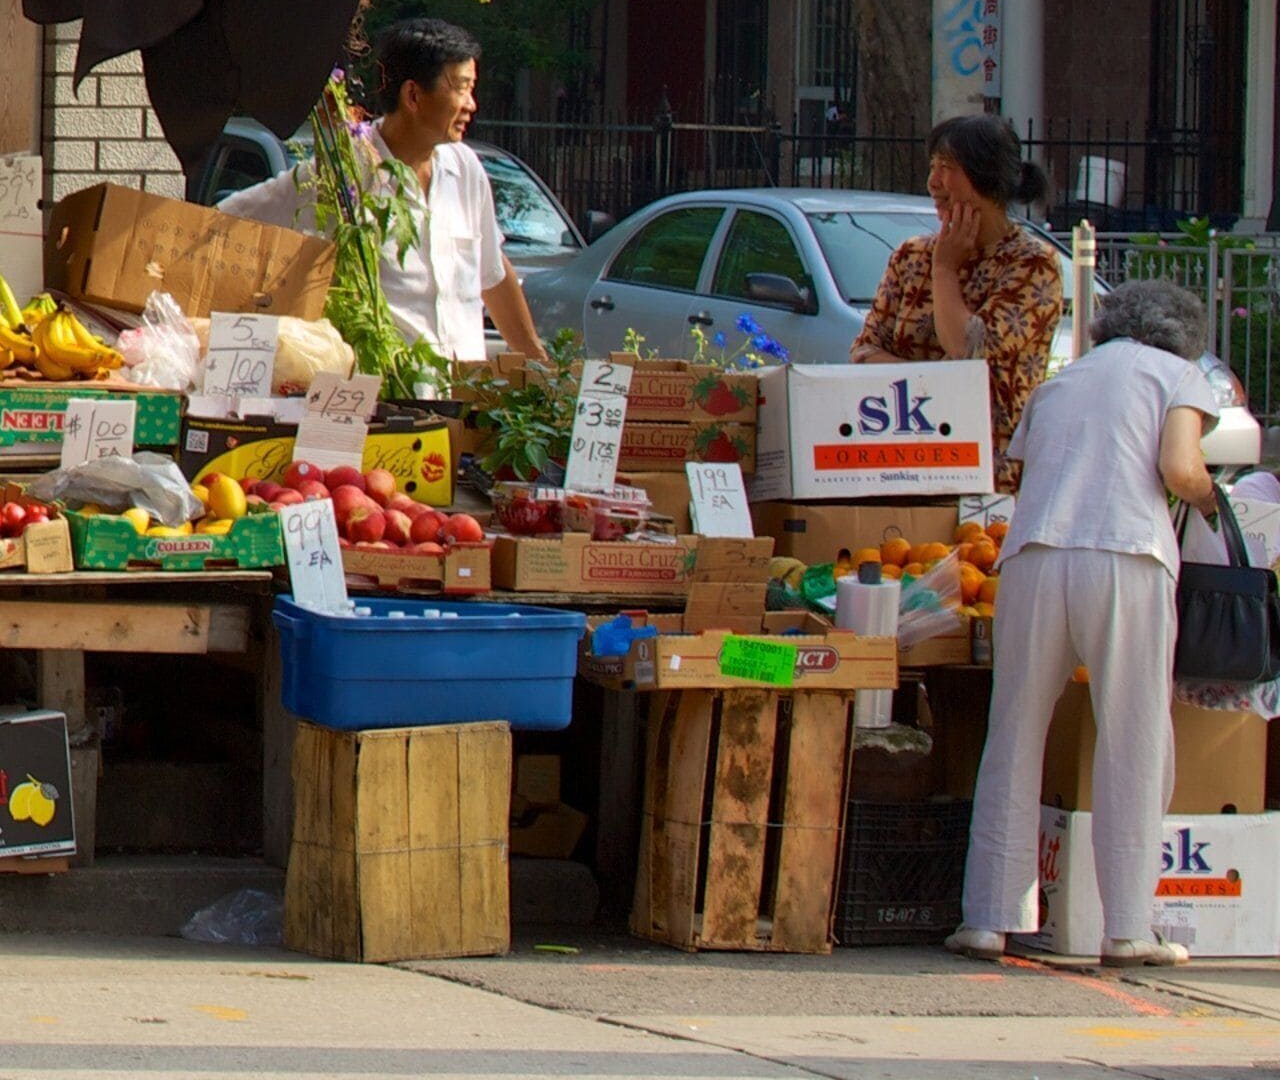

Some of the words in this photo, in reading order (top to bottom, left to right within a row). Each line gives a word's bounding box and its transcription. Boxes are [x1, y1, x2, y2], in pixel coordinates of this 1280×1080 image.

[232, 316, 259, 342] 5
[593, 364, 614, 386] 2
[648, 378, 688, 396] Cruz
[650, 429, 690, 446] Cruz
[836, 448, 961, 463] ORANGES
[879, 470, 919, 483] Sunkist
[157, 541, 212, 553] COLLEEN
[587, 547, 636, 568] Santa
[639, 547, 680, 568] Cruz
[1161, 882, 1227, 895] ANGES
